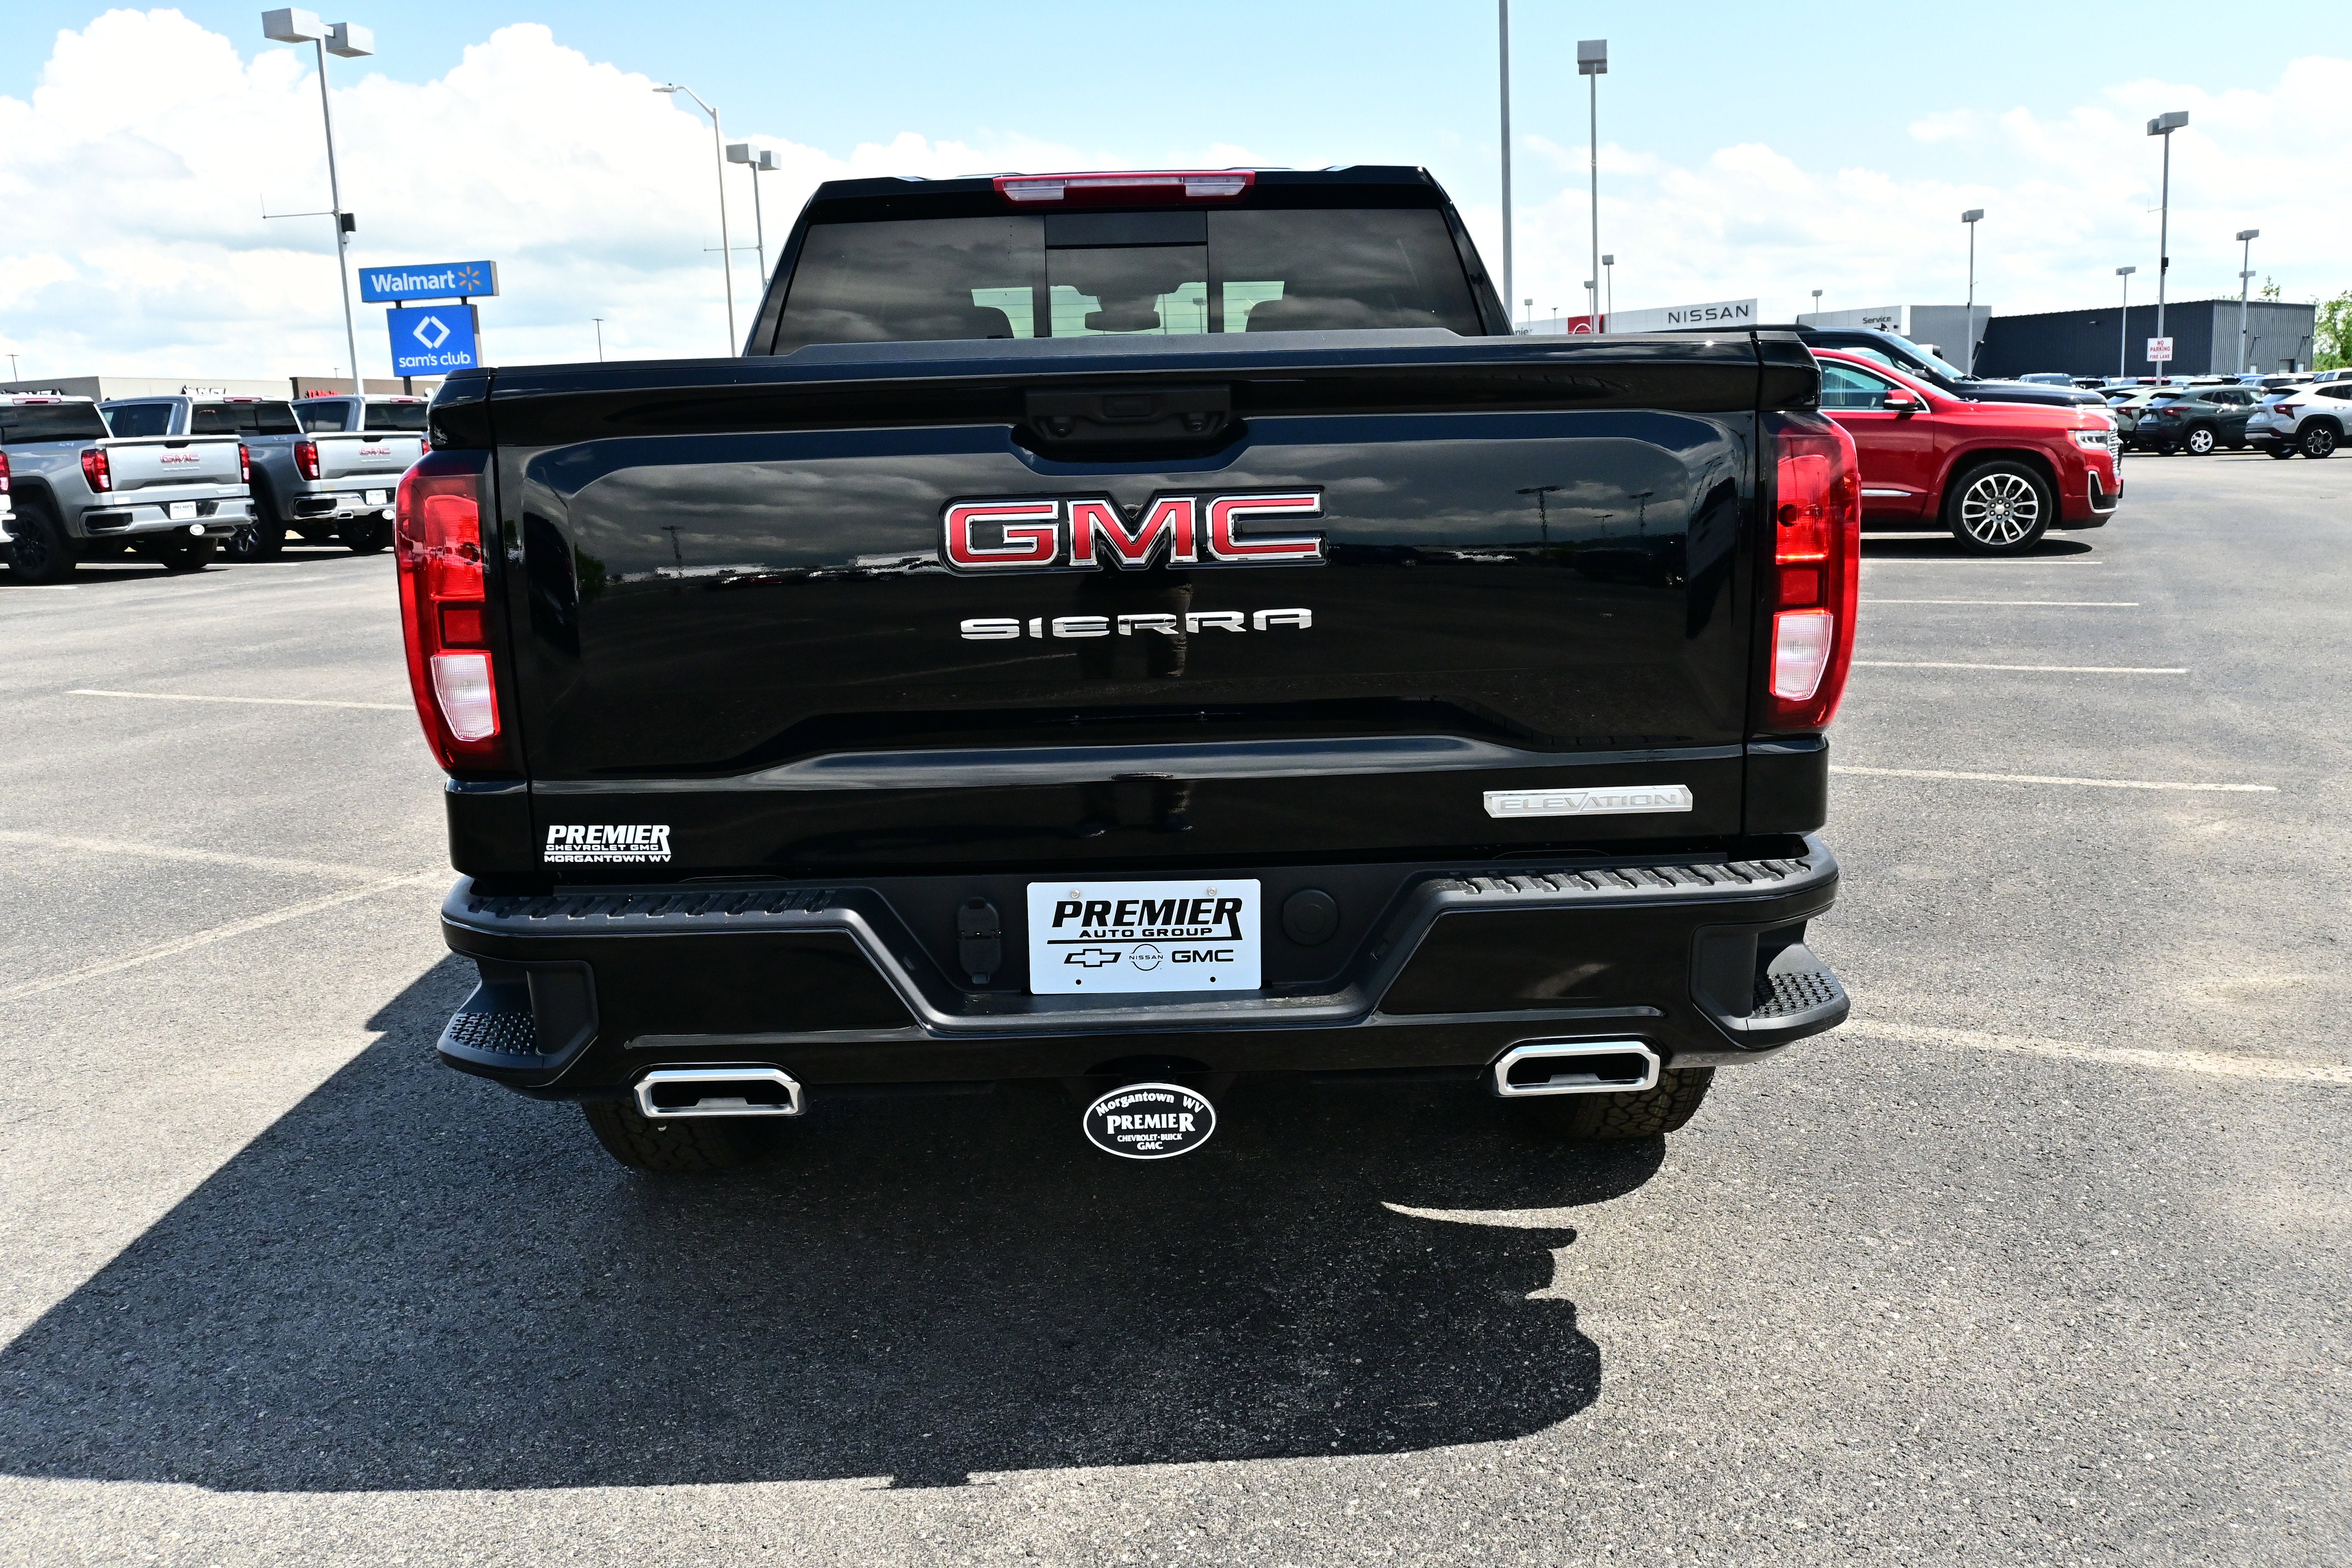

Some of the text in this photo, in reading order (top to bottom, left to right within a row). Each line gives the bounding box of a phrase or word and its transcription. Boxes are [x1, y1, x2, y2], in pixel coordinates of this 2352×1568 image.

[370, 270, 456, 292] Walmart
[1668, 305, 1748, 324] NISSAN
[1862, 316, 1892, 324] Service
[399, 351, 471, 367] sam's club
[161, 453, 201, 463] GMC
[359, 446, 391, 456] GMC
[945, 492, 1322, 567] GMC
[960, 608, 1312, 640] SIERRA
[1500, 793, 1677, 811] ELEVATION
[547, 825, 671, 851] PREMIER
[1052, 898, 1243, 940] PREMIER
[1079, 928, 1212, 938] AUTO GROUP
[1171, 950, 1234, 963] GMC
[1095, 1091, 1204, 1116] Morgantown WV
[1107, 1113, 1195, 1134] PREMIER
[1137, 1141, 1164, 1150] GMC
